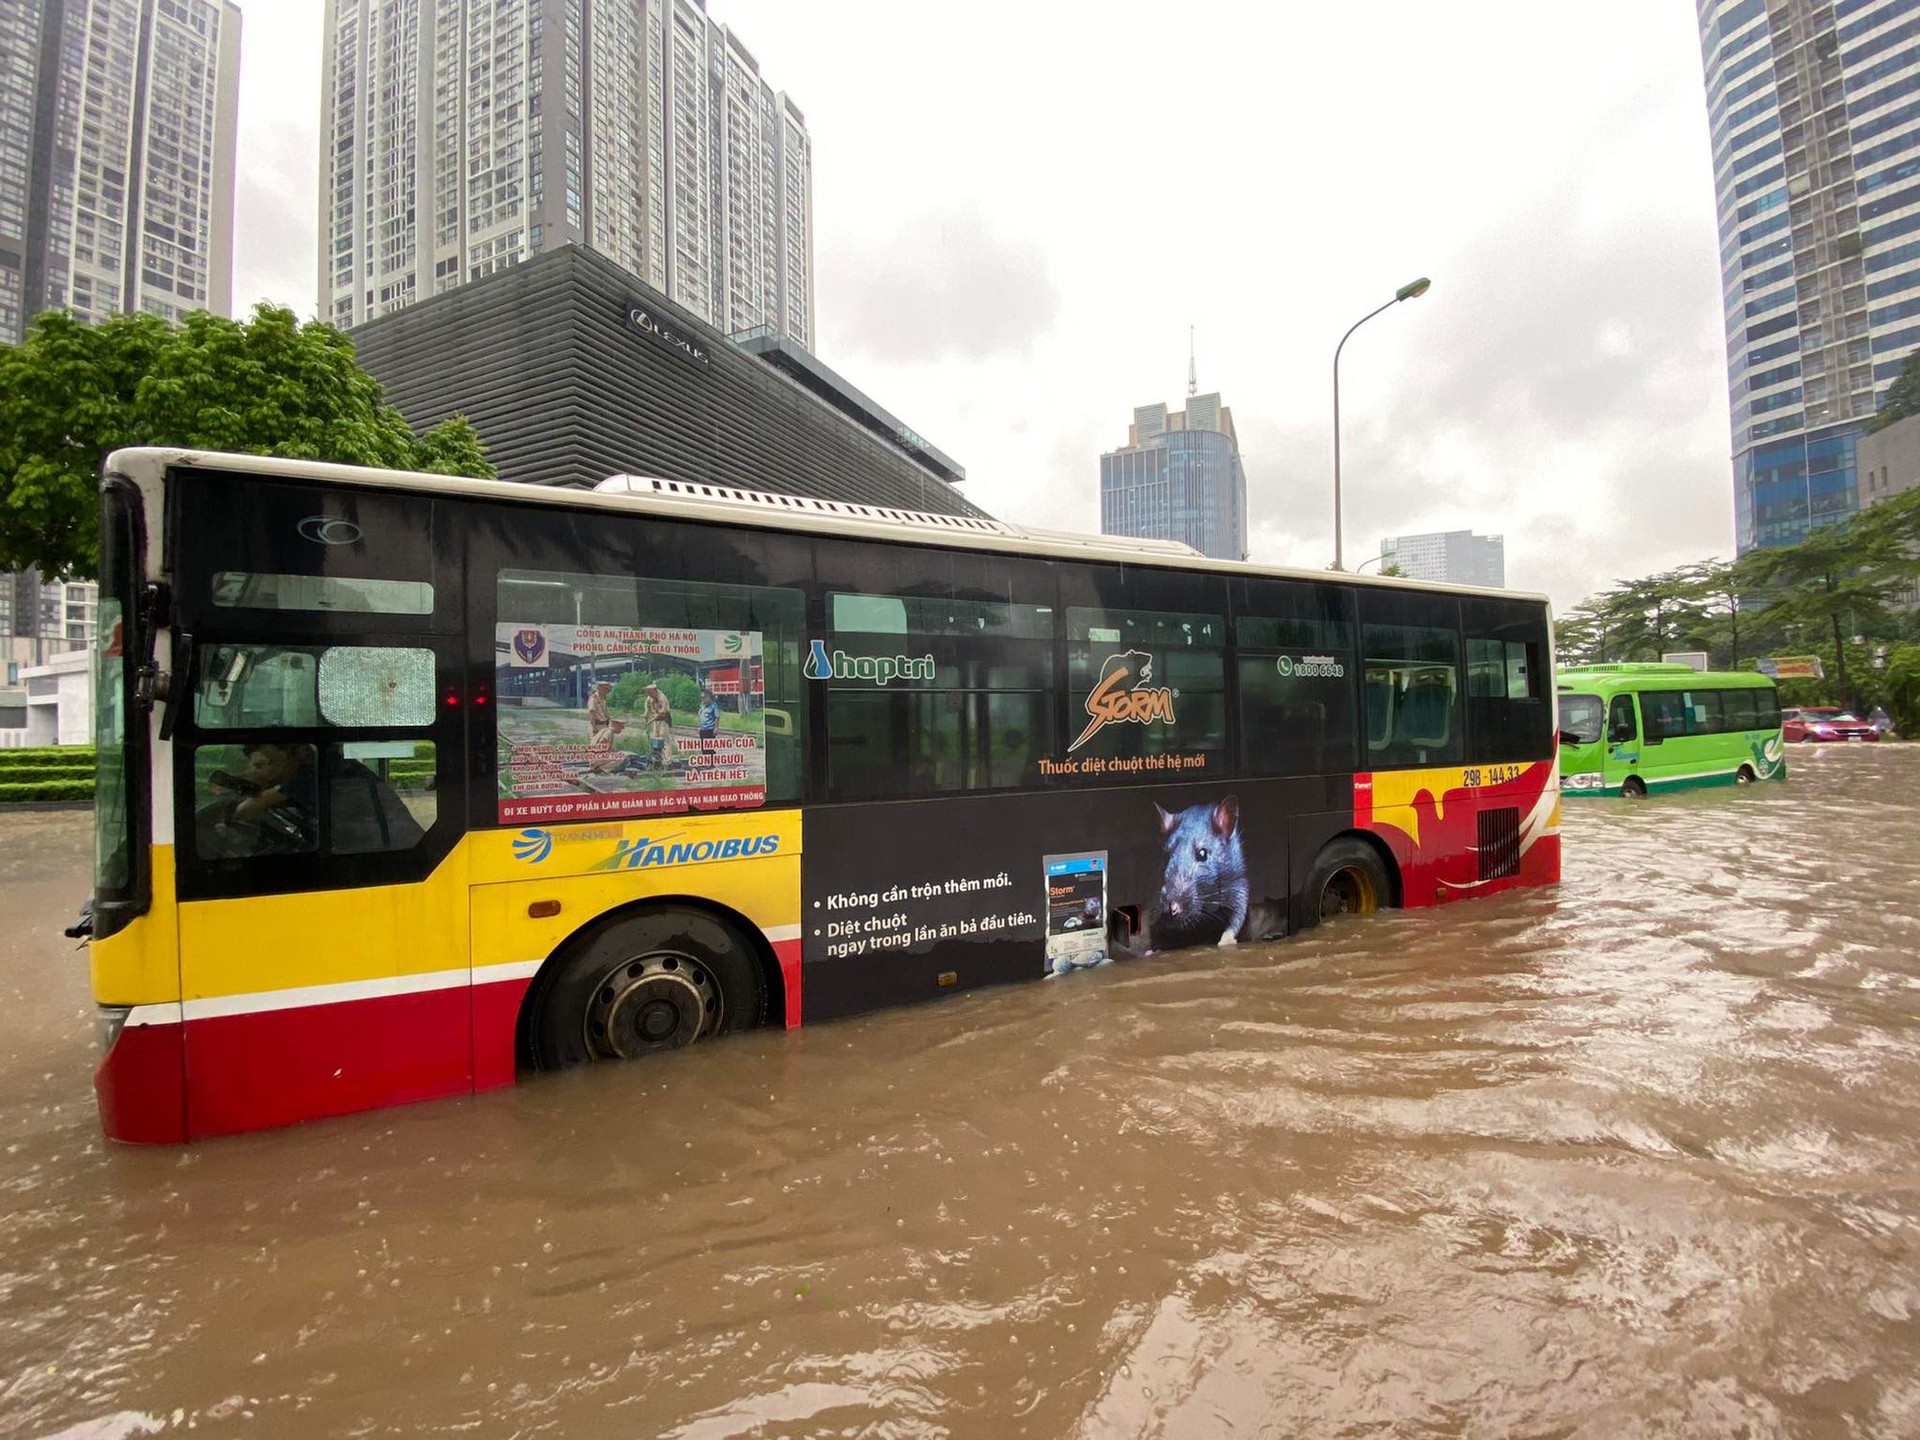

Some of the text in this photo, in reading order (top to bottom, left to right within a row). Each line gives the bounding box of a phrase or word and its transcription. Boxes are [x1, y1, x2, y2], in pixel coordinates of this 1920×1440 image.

[576, 629, 600, 638] CÔNG
[603, 630, 616, 639] AN
[682, 631, 697, 642] NỘI
[650, 644, 671, 653] GIAO
[673, 643, 700, 654] THÔNG
[833, 650, 936, 686] hoptri
[1294, 663, 1344, 678] 1800 6648
[677, 735, 755, 750] TÍNH MẠNG CỦA
[690, 755, 711, 766] CON
[1038, 753, 1205, 776] Thuốc diệt chuột thế hệ mới
[686, 767, 748, 782] LÀ TRÊN HẾT
[1463, 769, 1481, 787] 29B
[504, 807, 514, 816] ĐI
[516, 807, 528, 815] XE
[530, 803, 553, 814] BUÝT
[555, 802, 574, 813] GÓP
[602, 800, 619, 810] LÀM
[622, 798, 643, 809] GIẢM
[676, 796, 687, 805] VÀ
[689, 796, 701, 804] TAI
[720, 793, 738, 803] GIAO
[740, 792, 764, 801] THÔNG
[604, 834, 780, 869] HANOIBUS
[827, 892, 878, 910] Không
[882, 884, 908, 902] cần
[911, 883, 941, 901] trộn
[944, 877, 981, 895] thêm
[827, 913, 908, 938] Diệt chuột
[827, 940, 866, 958] ngay
[870, 933, 911, 950] trong
[914, 925, 937, 942] lần
[939, 924, 957, 938] ăn
[960, 918, 977, 935] bả
[980, 914, 1005, 931] đầu
[1008, 911, 1037, 928] tiên.
